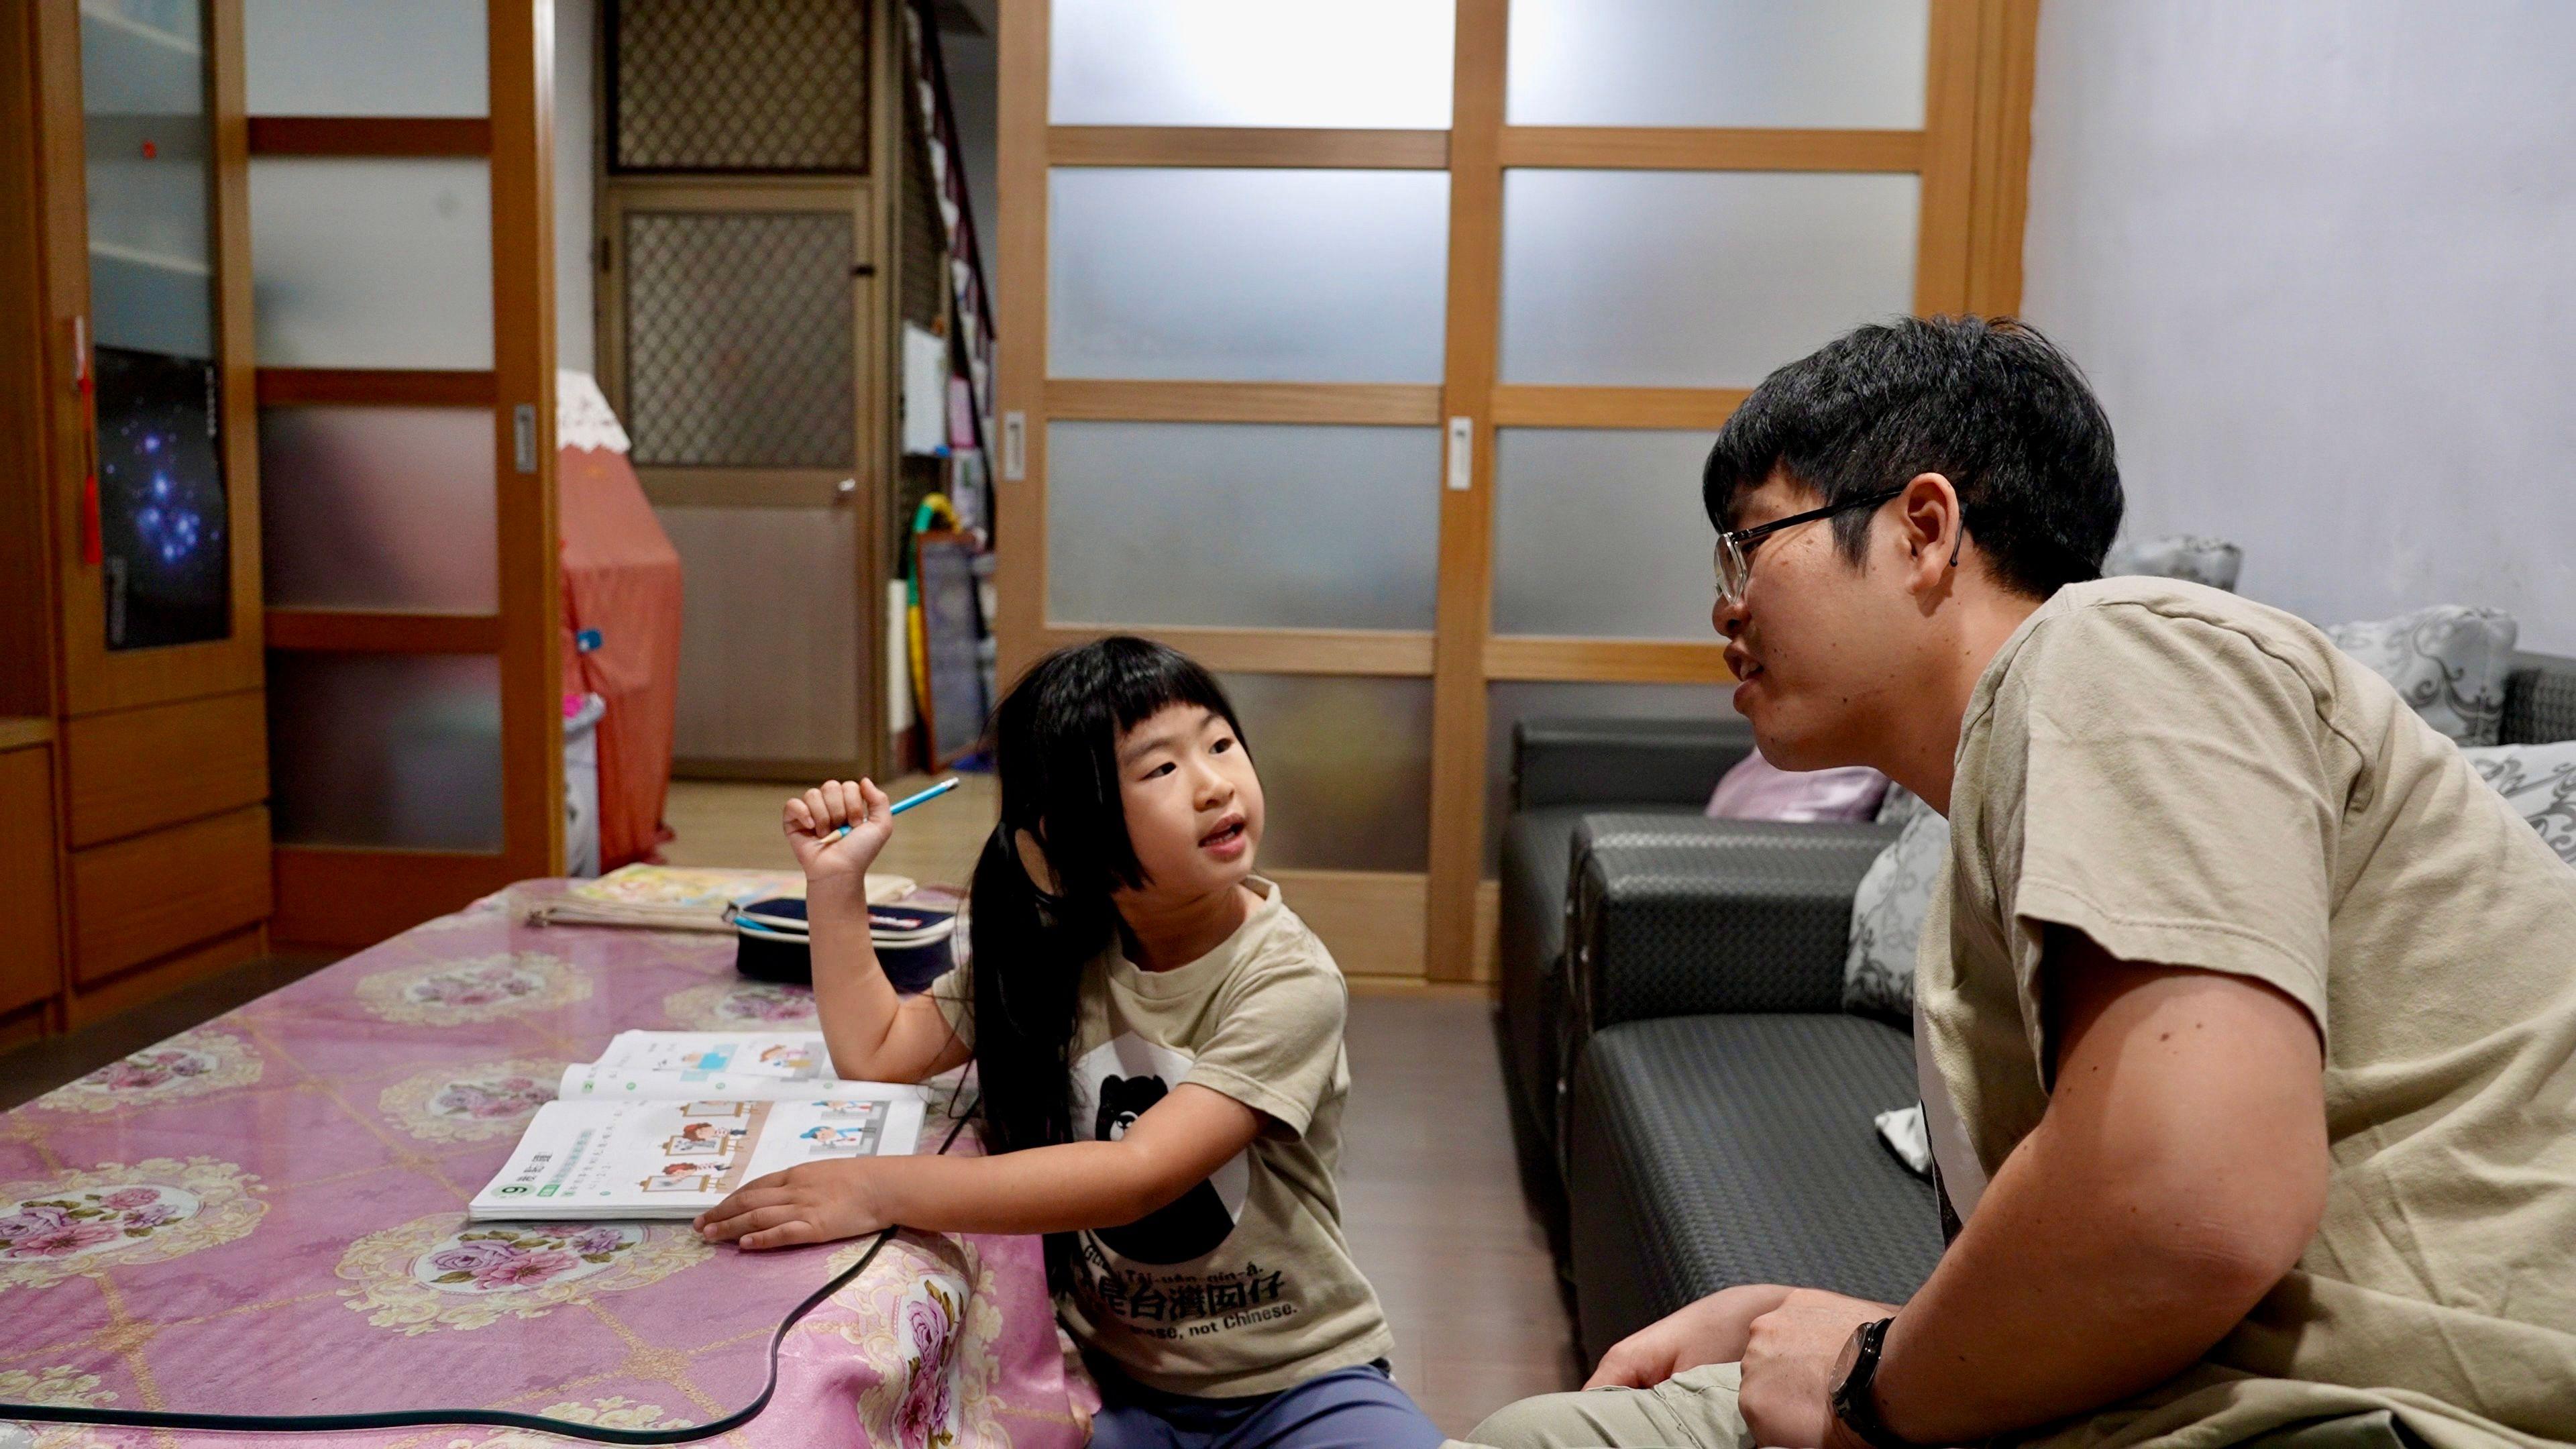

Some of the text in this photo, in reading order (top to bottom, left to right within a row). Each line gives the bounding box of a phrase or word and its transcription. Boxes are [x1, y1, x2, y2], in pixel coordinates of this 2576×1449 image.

[501, 1186, 528, 1194] 9
[1189, 1322, 1220, 1337] not
[1224, 1304, 1298, 1328] Chinese.
